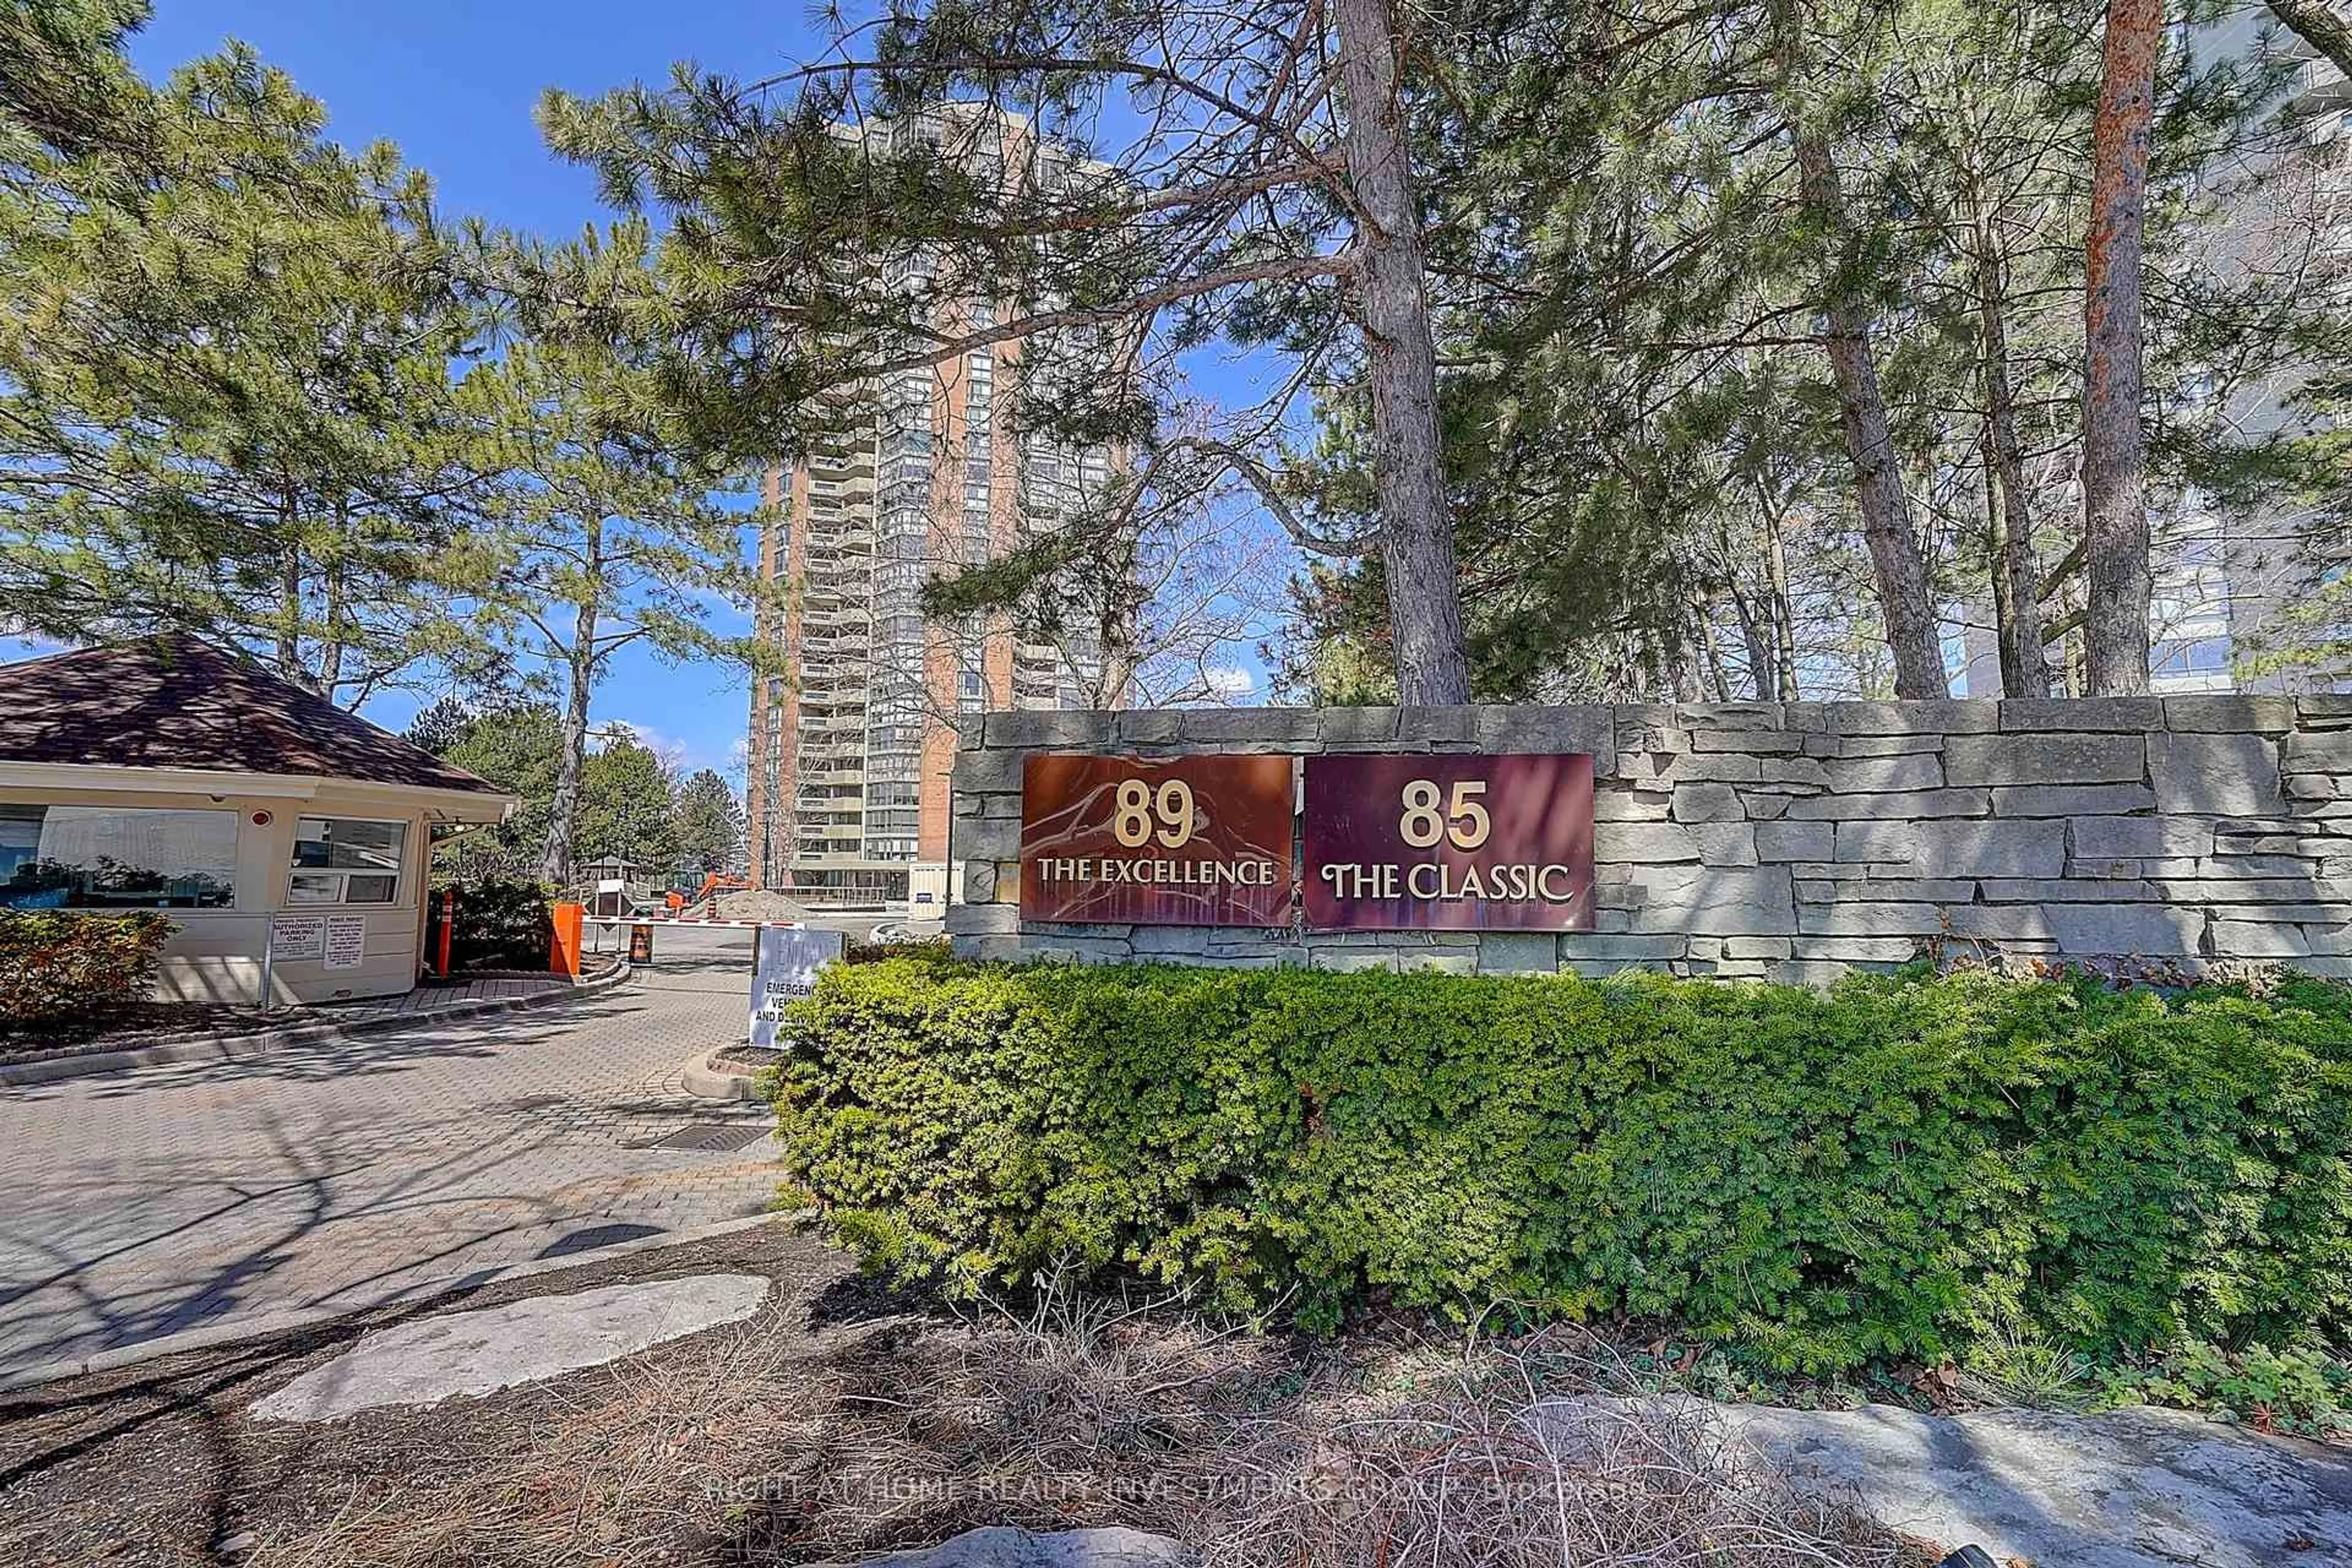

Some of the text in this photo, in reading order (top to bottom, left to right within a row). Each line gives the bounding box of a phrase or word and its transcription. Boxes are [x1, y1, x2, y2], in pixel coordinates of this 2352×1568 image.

[1115, 778, 1194, 848] 89
[1400, 779, 1490, 849] 85
[1038, 858, 1273, 885] THE EXCELLENCE
[1321, 864, 1574, 900] THE CLASSIC
[767, 982, 817, 995] EMERGENC
[756, 1011, 775, 1022] AND
